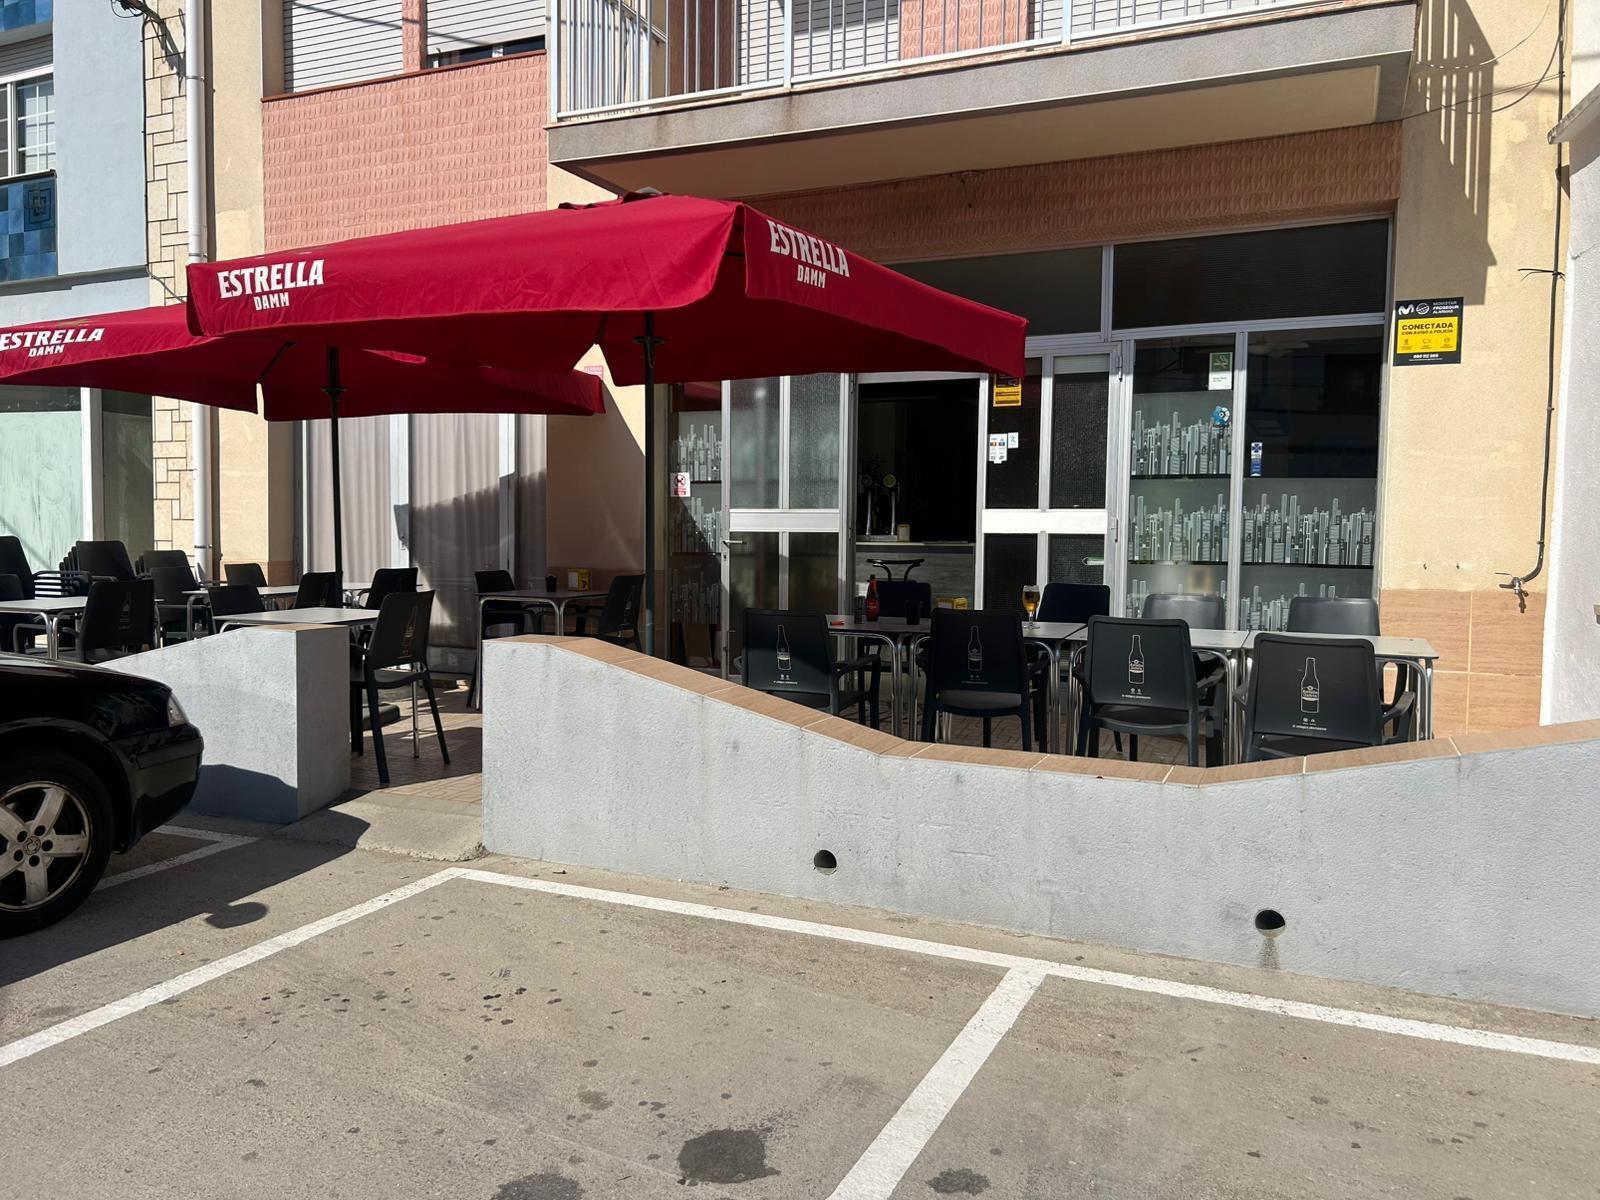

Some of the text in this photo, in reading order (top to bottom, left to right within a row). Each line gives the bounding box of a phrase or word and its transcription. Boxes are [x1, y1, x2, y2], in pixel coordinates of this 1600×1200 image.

[766, 219, 850, 278] ESTRELLA
[217, 259, 325, 299] ESTRELLA
[797, 264, 827, 289] DAMM
[253, 292, 290, 311] DAMM
[1401, 322, 1454, 331] CONECTADA
[0, 328, 105, 352] ESTRELLA
[28, 344, 65, 358] DAMM
